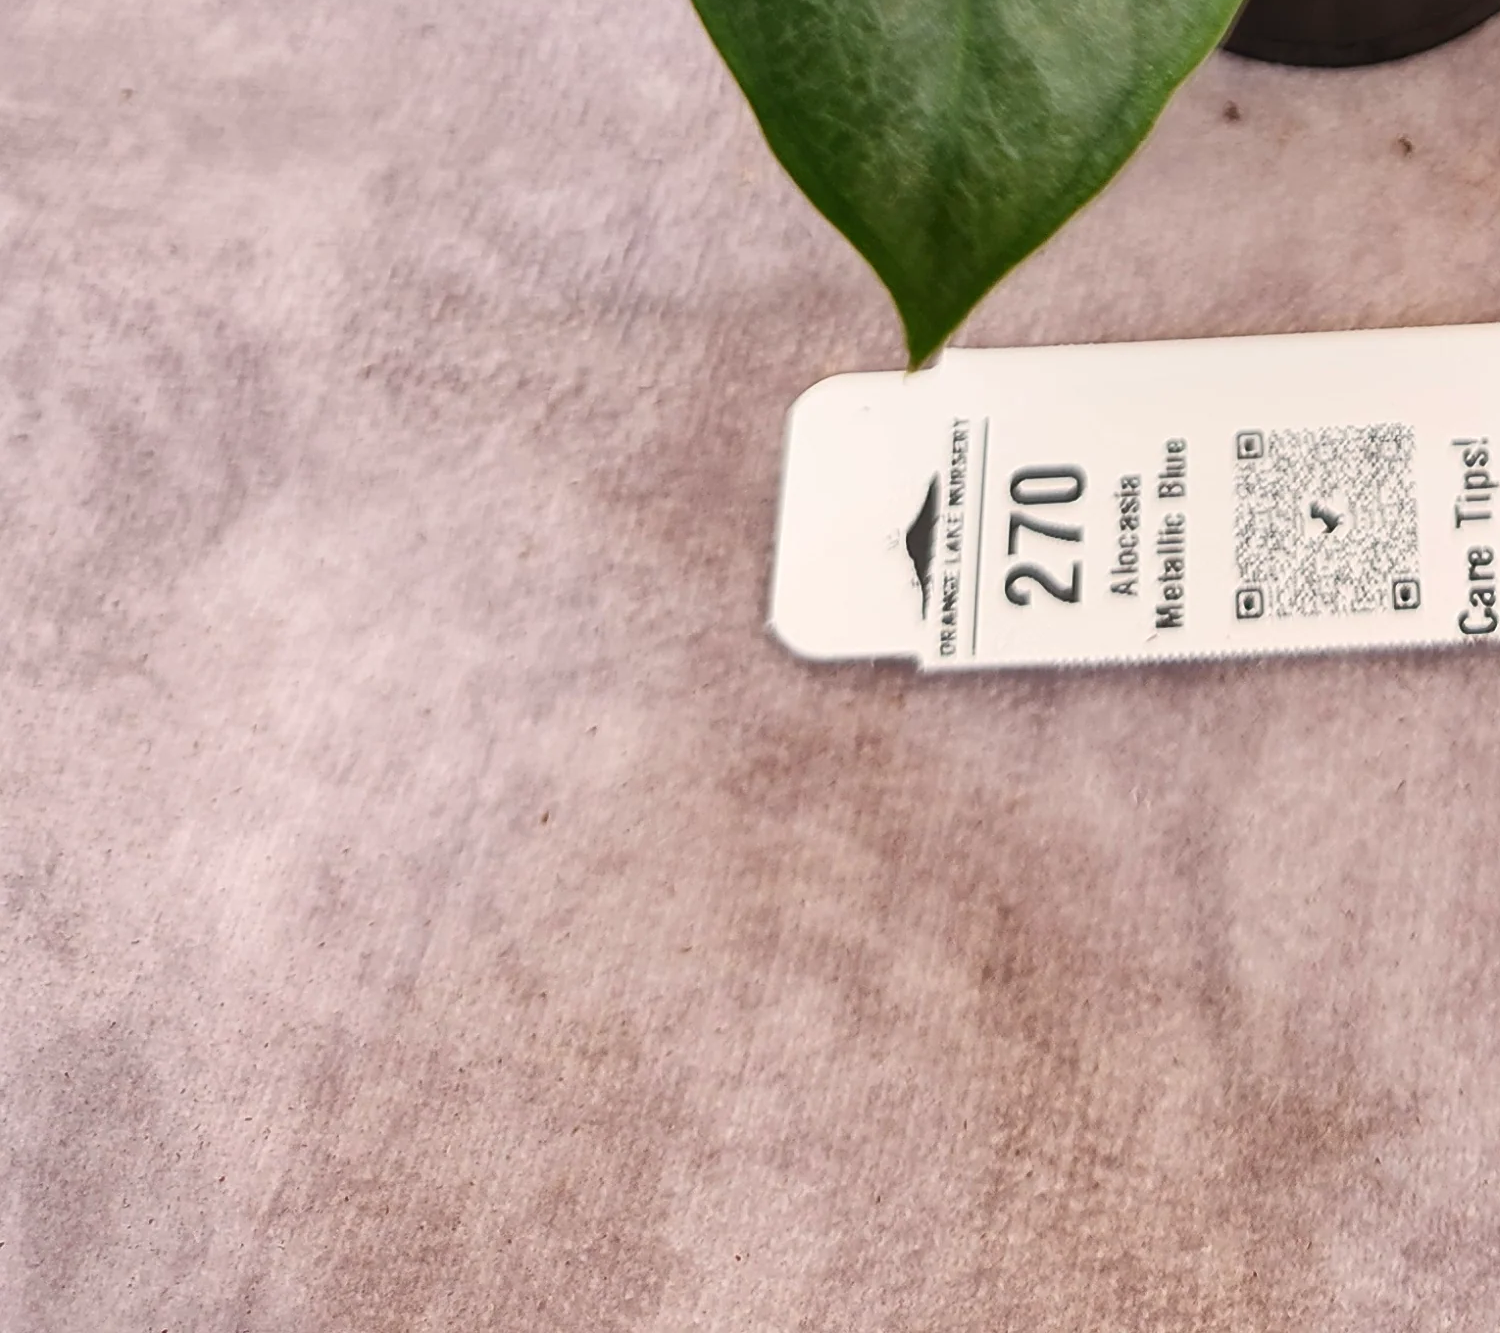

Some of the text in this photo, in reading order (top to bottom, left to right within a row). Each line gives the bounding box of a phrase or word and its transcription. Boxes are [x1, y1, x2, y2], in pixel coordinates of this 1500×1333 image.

[940, 417, 970, 657] ORANGE LAKE NURSERY
[1004, 463, 1087, 606] 270
[1110, 473, 1142, 597] Alocasia
[1155, 437, 1188, 630] Metallic Blue
[1451, 436, 1500, 635] Care Tips!
